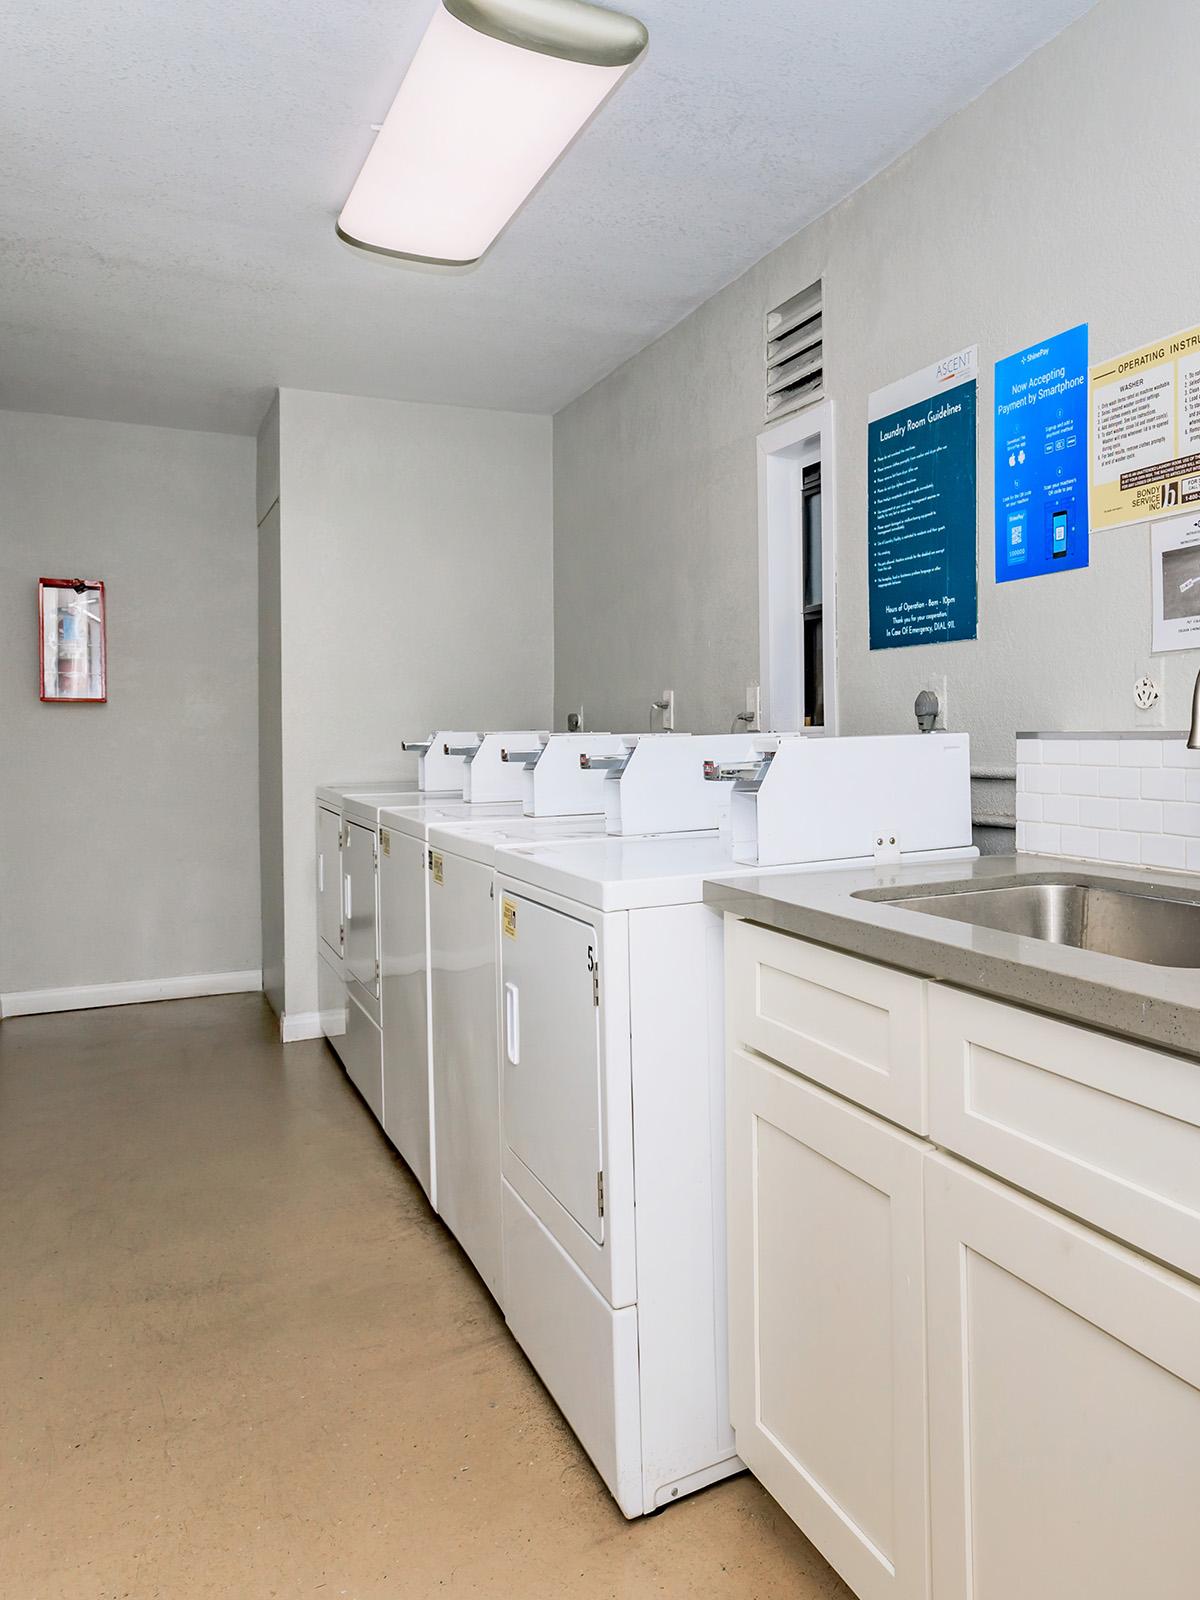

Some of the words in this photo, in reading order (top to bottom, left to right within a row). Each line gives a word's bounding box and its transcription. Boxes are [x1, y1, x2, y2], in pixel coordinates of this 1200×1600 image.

[1027, 348, 1050, 362] ShinePay
[1117, 348, 1164, 373] OPERATING
[936, 351, 972, 377] ASCENT
[1012, 382, 1027, 395] Now
[1028, 367, 1066, 387] Accepting
[1119, 378, 1144, 391] WASHER
[998, 396, 1027, 415] Payment
[1028, 392, 1037, 404] by
[1038, 375, 1084, 400] Smartphone
[880, 424, 905, 441] Laundry
[907, 415, 926, 432] Room
[928, 403, 961, 423] Guidelines
[1136, 485, 1160, 498] BONDY
[1131, 493, 1160, 507] SERVICE
[1148, 501, 1160, 510] INC
[898, 602, 902, 611] of
[903, 601, 924, 611] Operation
[928, 598, 938, 606] 8am
[942, 595, 955, 605] 10pm
[885, 628, 890, 636] In
[890, 627, 900, 636] Case
[901, 625, 908, 634] Of
[908, 625, 933, 634] Emergency,
[933, 621, 946, 630] DIAL
[587, 945, 594, 972] 5
